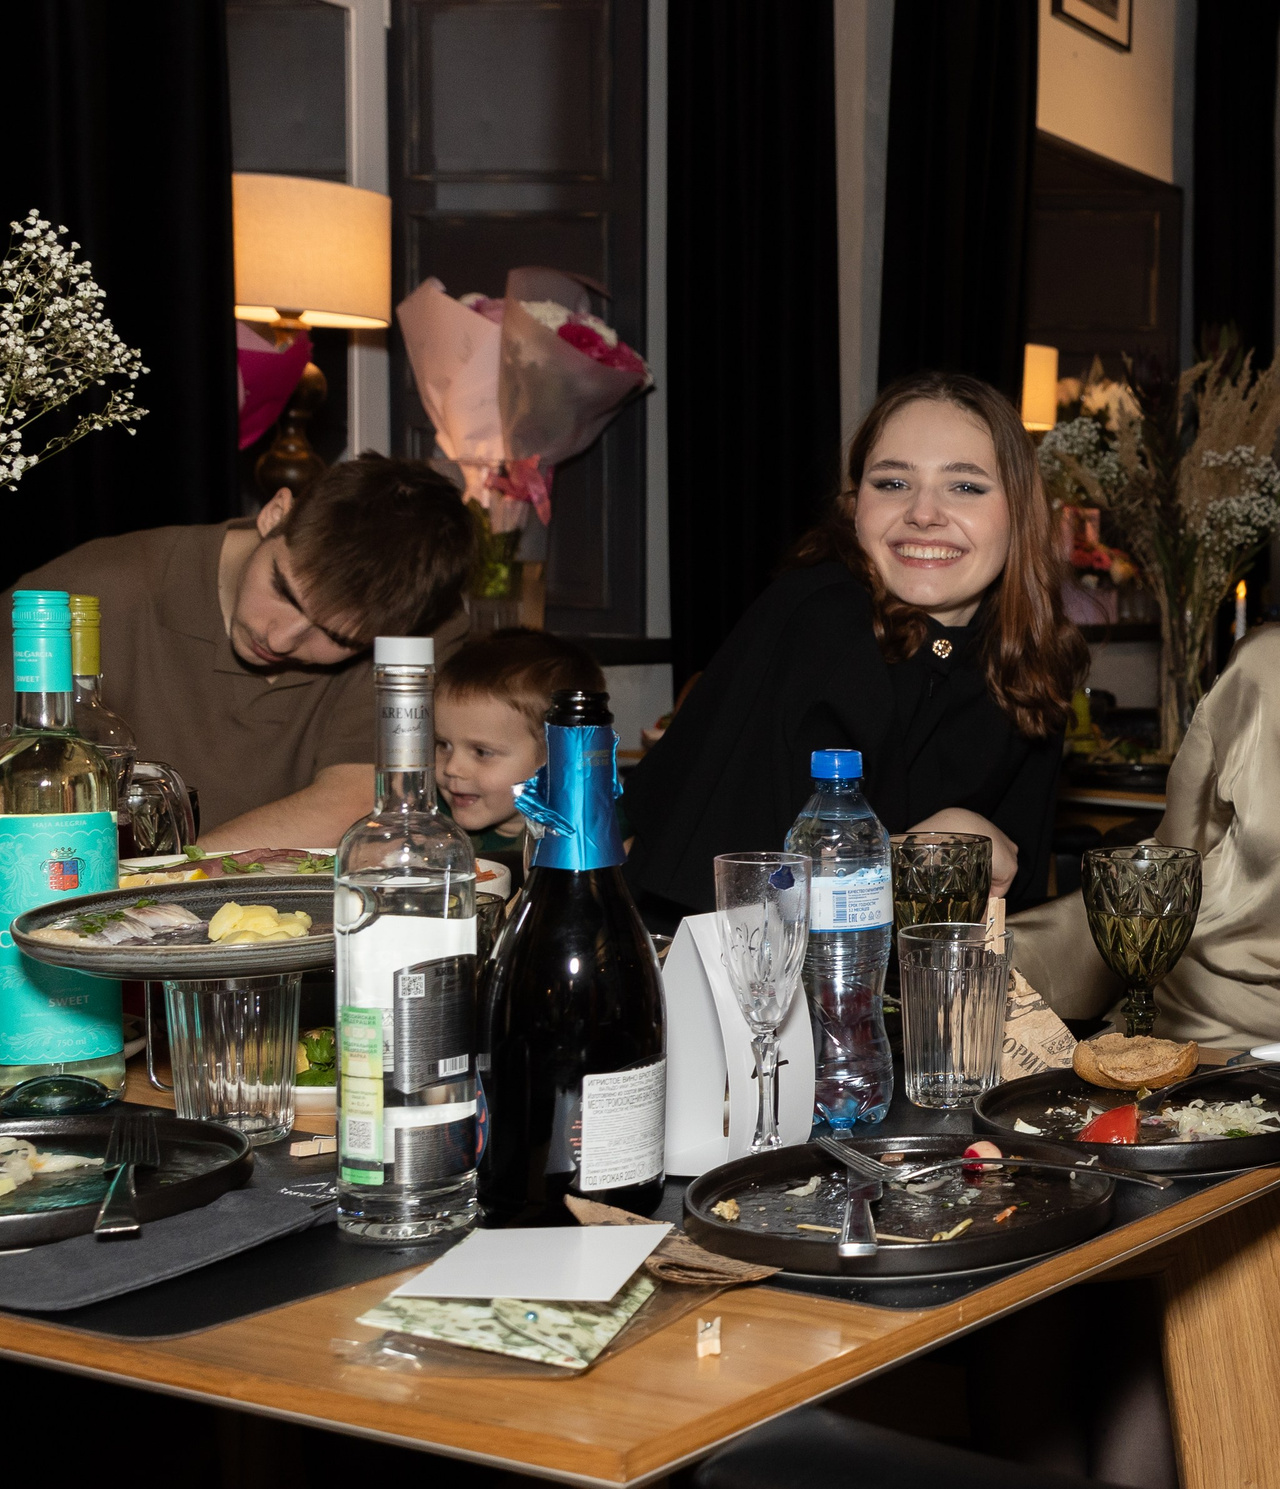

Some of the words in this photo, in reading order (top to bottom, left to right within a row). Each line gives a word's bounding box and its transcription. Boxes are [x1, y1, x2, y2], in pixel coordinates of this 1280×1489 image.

[16, 675, 40, 683] SWEET
[48, 995, 90, 1008] SWEET
[57, 1039, 74, 1048] 750
[76, 1037, 87, 1046] ml
[622, 1074, 637, 1083] ВИНО
